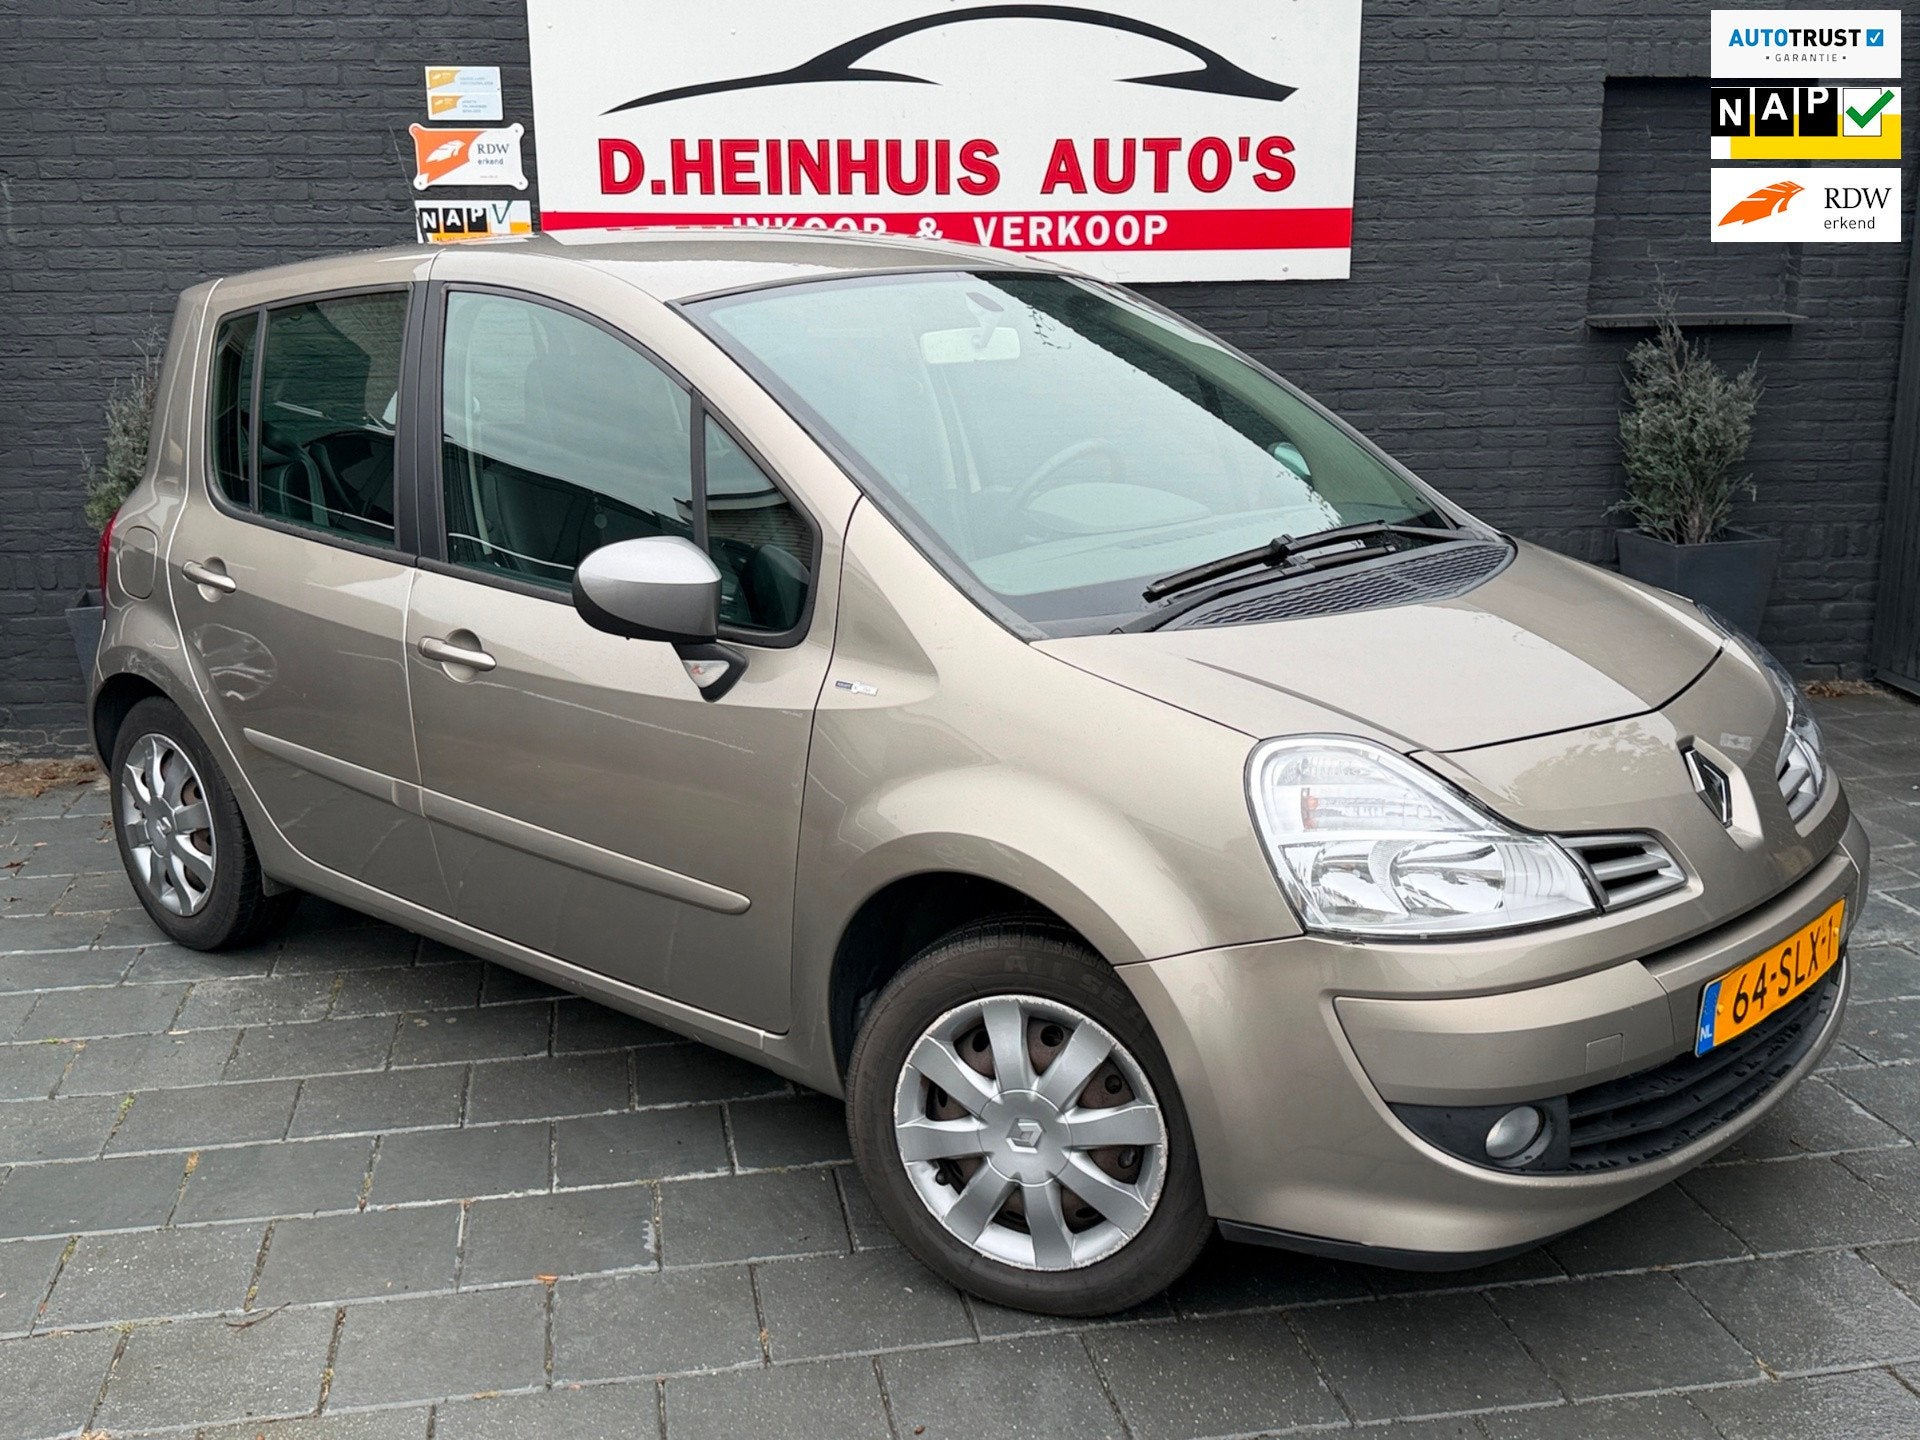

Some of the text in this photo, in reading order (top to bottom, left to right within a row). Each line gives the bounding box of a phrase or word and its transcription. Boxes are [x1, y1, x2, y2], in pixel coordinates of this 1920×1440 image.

[477, 143, 510, 154] RDW
[477, 157, 504, 166] erkend
[598, 136, 1296, 196] D.HEINHUIS AUTO'S
[421, 208, 484, 229] NAP
[972, 214, 1168, 247] VERKOOP
[1700, 1024, 1712, 1042] NL
